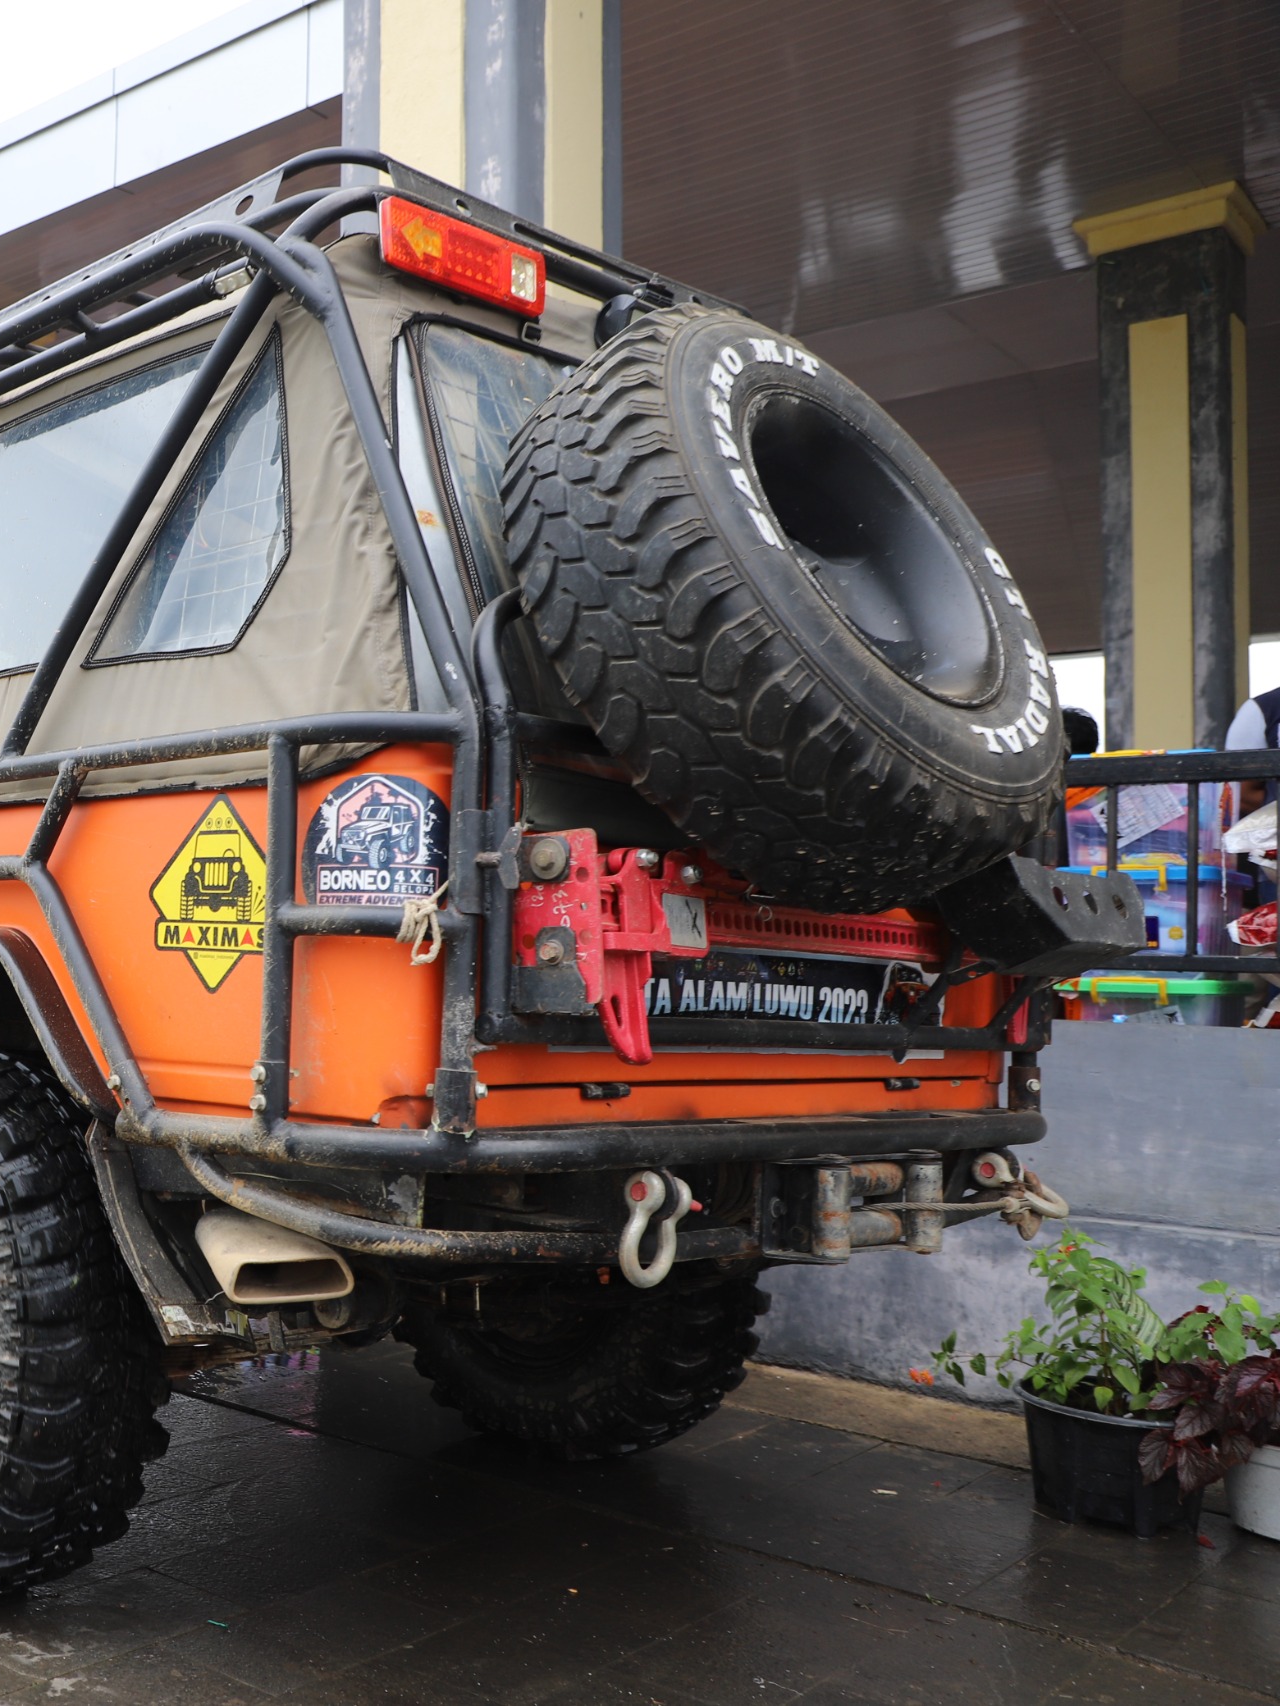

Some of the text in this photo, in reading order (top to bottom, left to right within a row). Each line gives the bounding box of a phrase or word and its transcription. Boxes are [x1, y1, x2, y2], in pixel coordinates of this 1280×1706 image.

[748, 338, 820, 377] M/T
[971, 547, 1052, 754] GT RADIAL
[320, 869, 391, 891] BORNEO
[393, 884, 434, 895] BELOPA
[319, 895, 364, 905] EXTREME
[679, 979, 747, 1012] ALAM
[753, 982, 814, 1020] LUWU
[818, 986, 868, 1024] 2023
